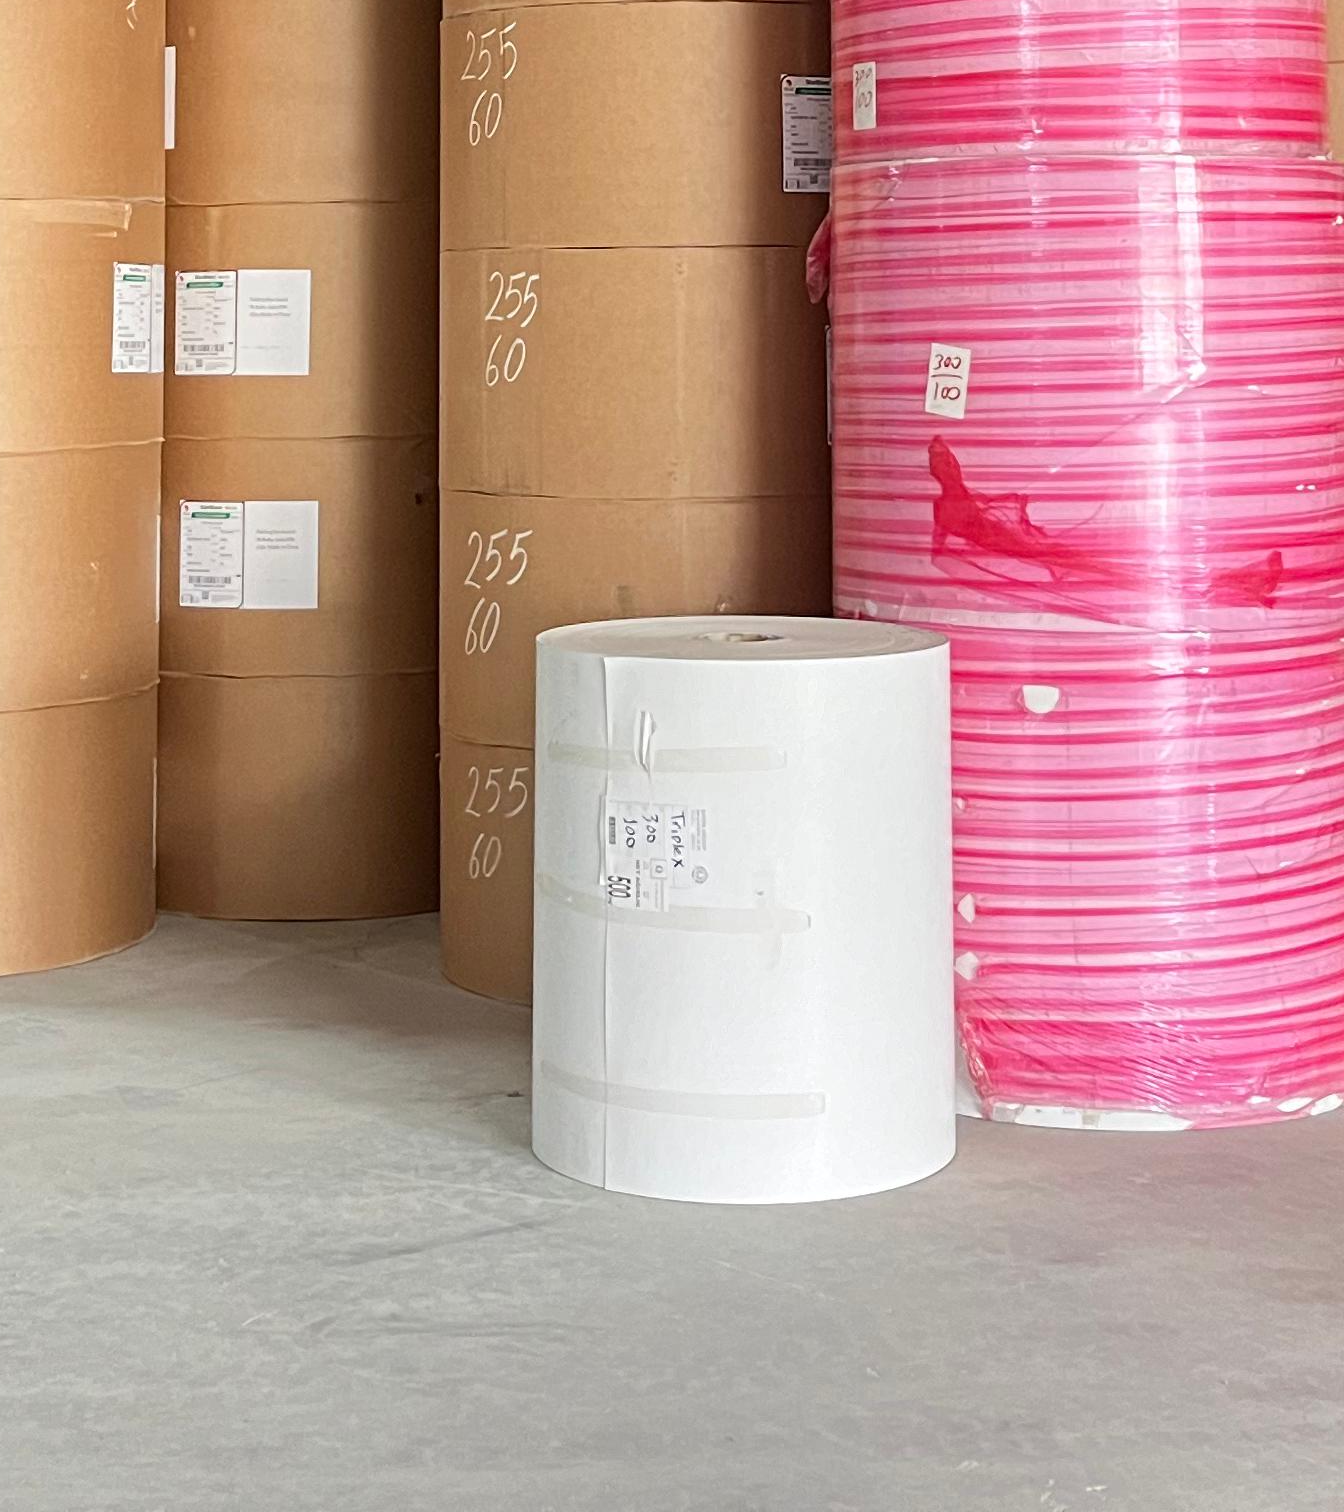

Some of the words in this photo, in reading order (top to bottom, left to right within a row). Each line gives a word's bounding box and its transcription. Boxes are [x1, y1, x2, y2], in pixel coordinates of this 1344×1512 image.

[460, 22, 517, 81] 255
[469, 90, 502, 146] 60
[485, 271, 540, 328] 255
[485, 334, 526, 387] 60
[932, 354, 962, 370] 300
[934, 382, 961, 400] 100
[464, 529, 533, 589] 255
[464, 597, 501, 655] 60
[464, 766, 529, 818] 255
[622, 817, 638, 848] 100
[641, 814, 659, 844] 300
[671, 810, 686, 868] Triplex
[468, 833, 502, 880] 60
[607, 875, 631, 899] 500
